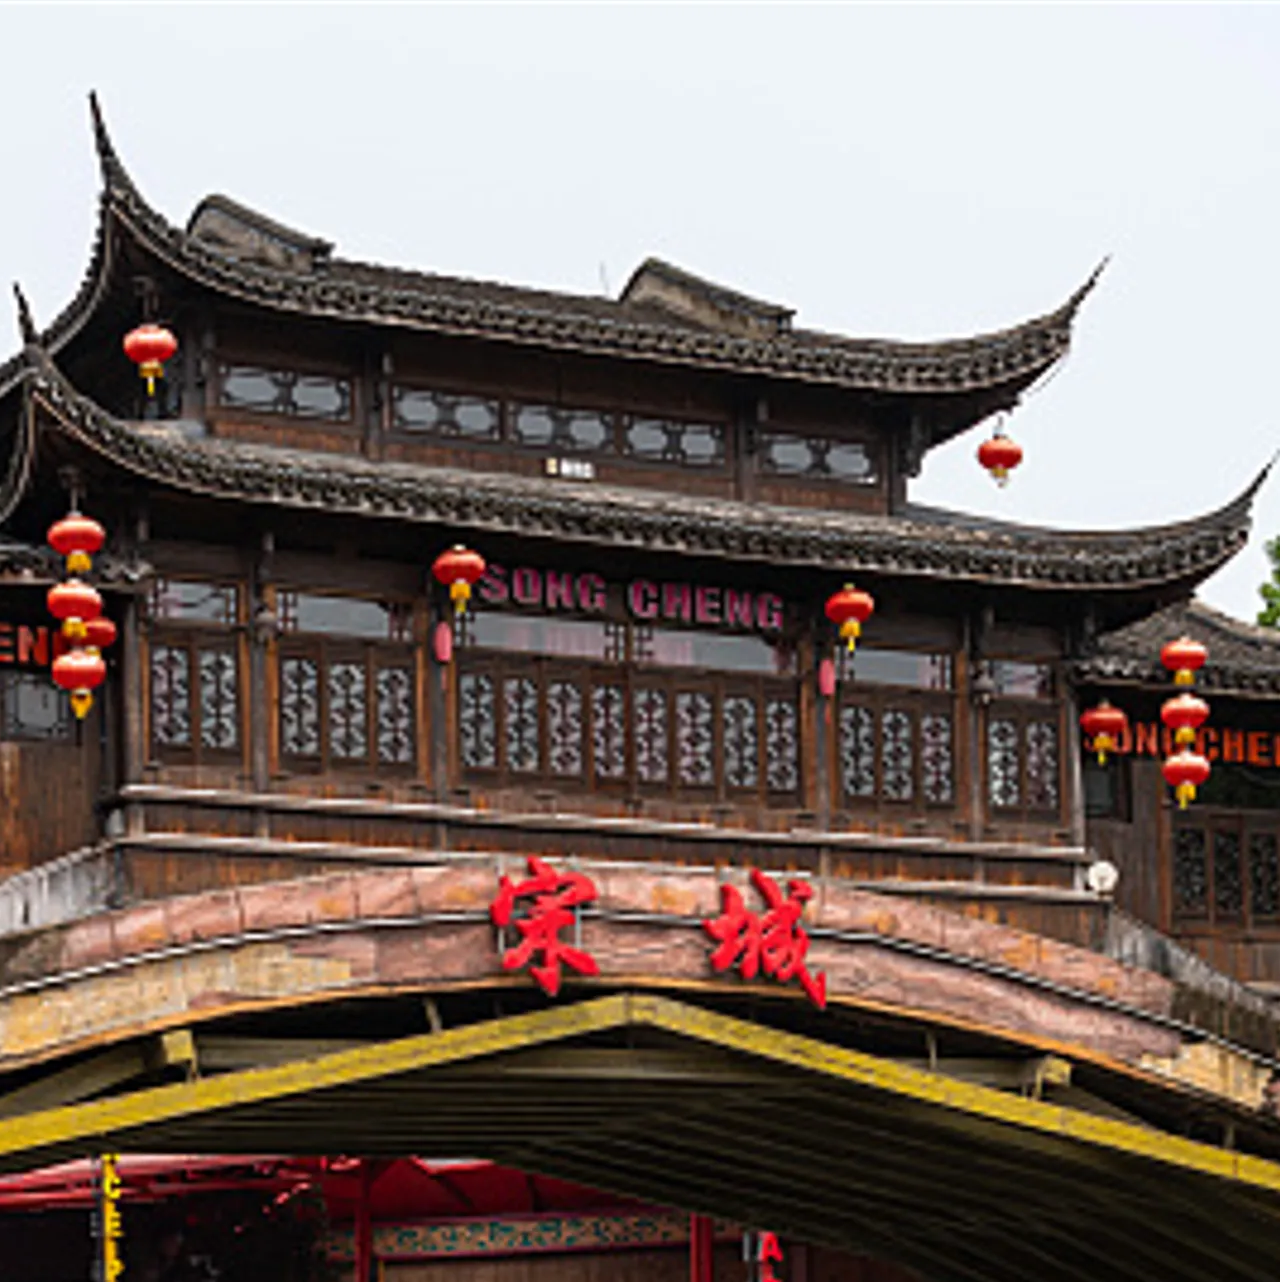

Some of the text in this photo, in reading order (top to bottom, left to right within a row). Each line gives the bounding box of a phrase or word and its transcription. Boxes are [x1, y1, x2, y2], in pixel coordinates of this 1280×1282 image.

[480, 563, 783, 629] SONG CHENG
[489, 855, 826, 1010] 宋城
